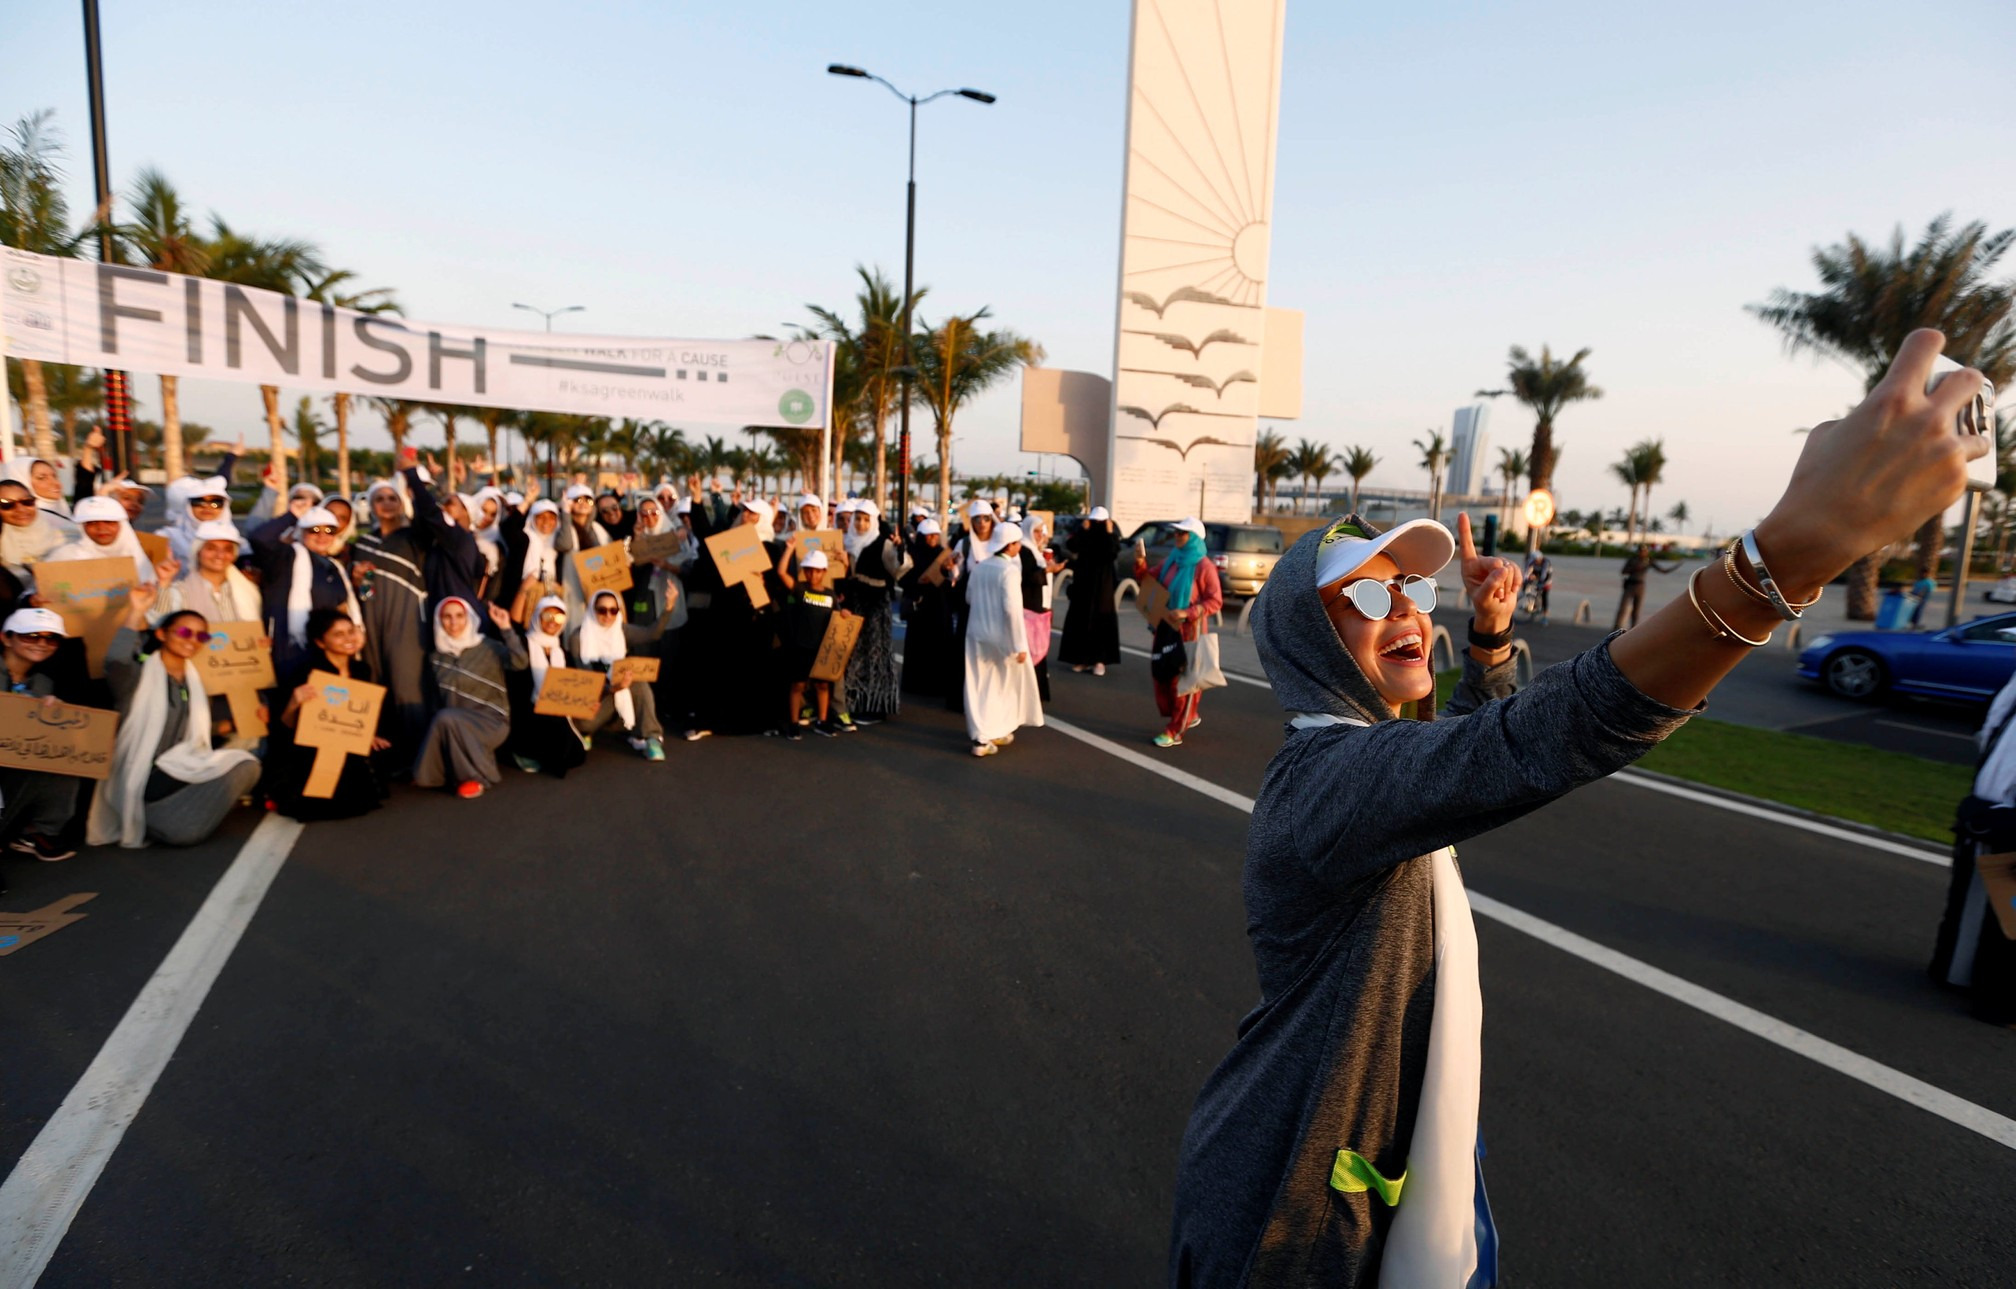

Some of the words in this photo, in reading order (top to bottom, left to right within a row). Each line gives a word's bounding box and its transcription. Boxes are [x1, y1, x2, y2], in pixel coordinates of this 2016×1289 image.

[97, 263, 487, 395] FINISH
[667, 350, 678, 365] A
[681, 351, 728, 367] CAUSE
[558, 376, 685, 403] #ksagreenwalk
